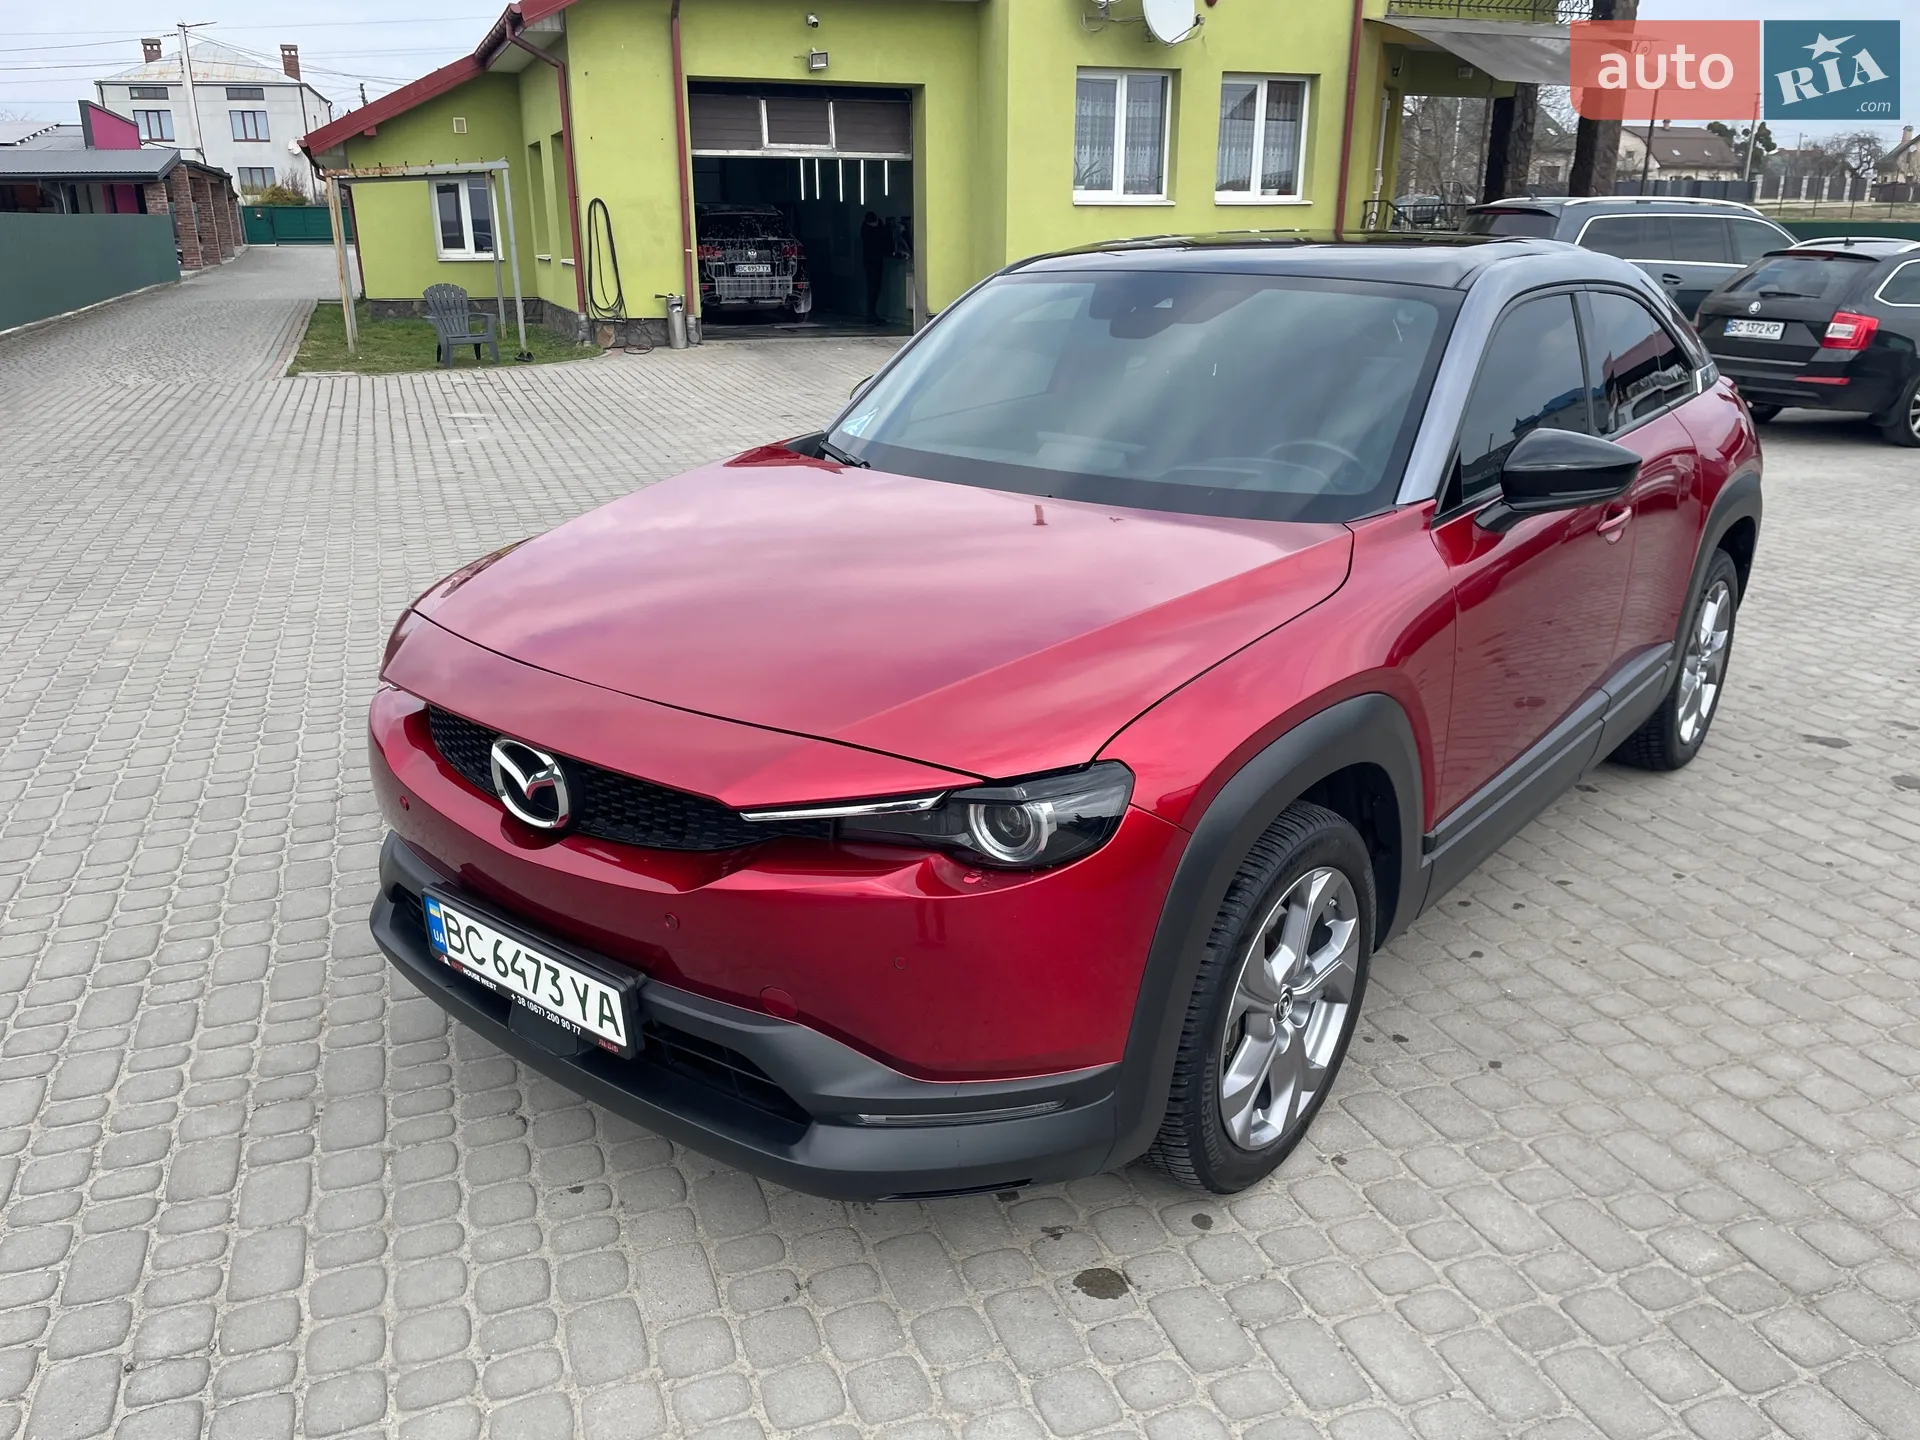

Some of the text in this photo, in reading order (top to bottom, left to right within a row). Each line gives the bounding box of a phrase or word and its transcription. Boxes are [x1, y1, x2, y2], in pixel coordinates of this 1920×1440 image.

[1730, 321, 1744, 332] BC
[1765, 323, 1780, 335] KP
[433, 928, 446, 945] UA
[443, 910, 622, 1038] BC 6473 YA
[480, 977, 498, 991] WEST
[516, 995, 526, 1007] 38
[546, 1010, 560, 1025] 200
[561, 1018, 571, 1030] 90
[571, 1024, 581, 1036] 77
